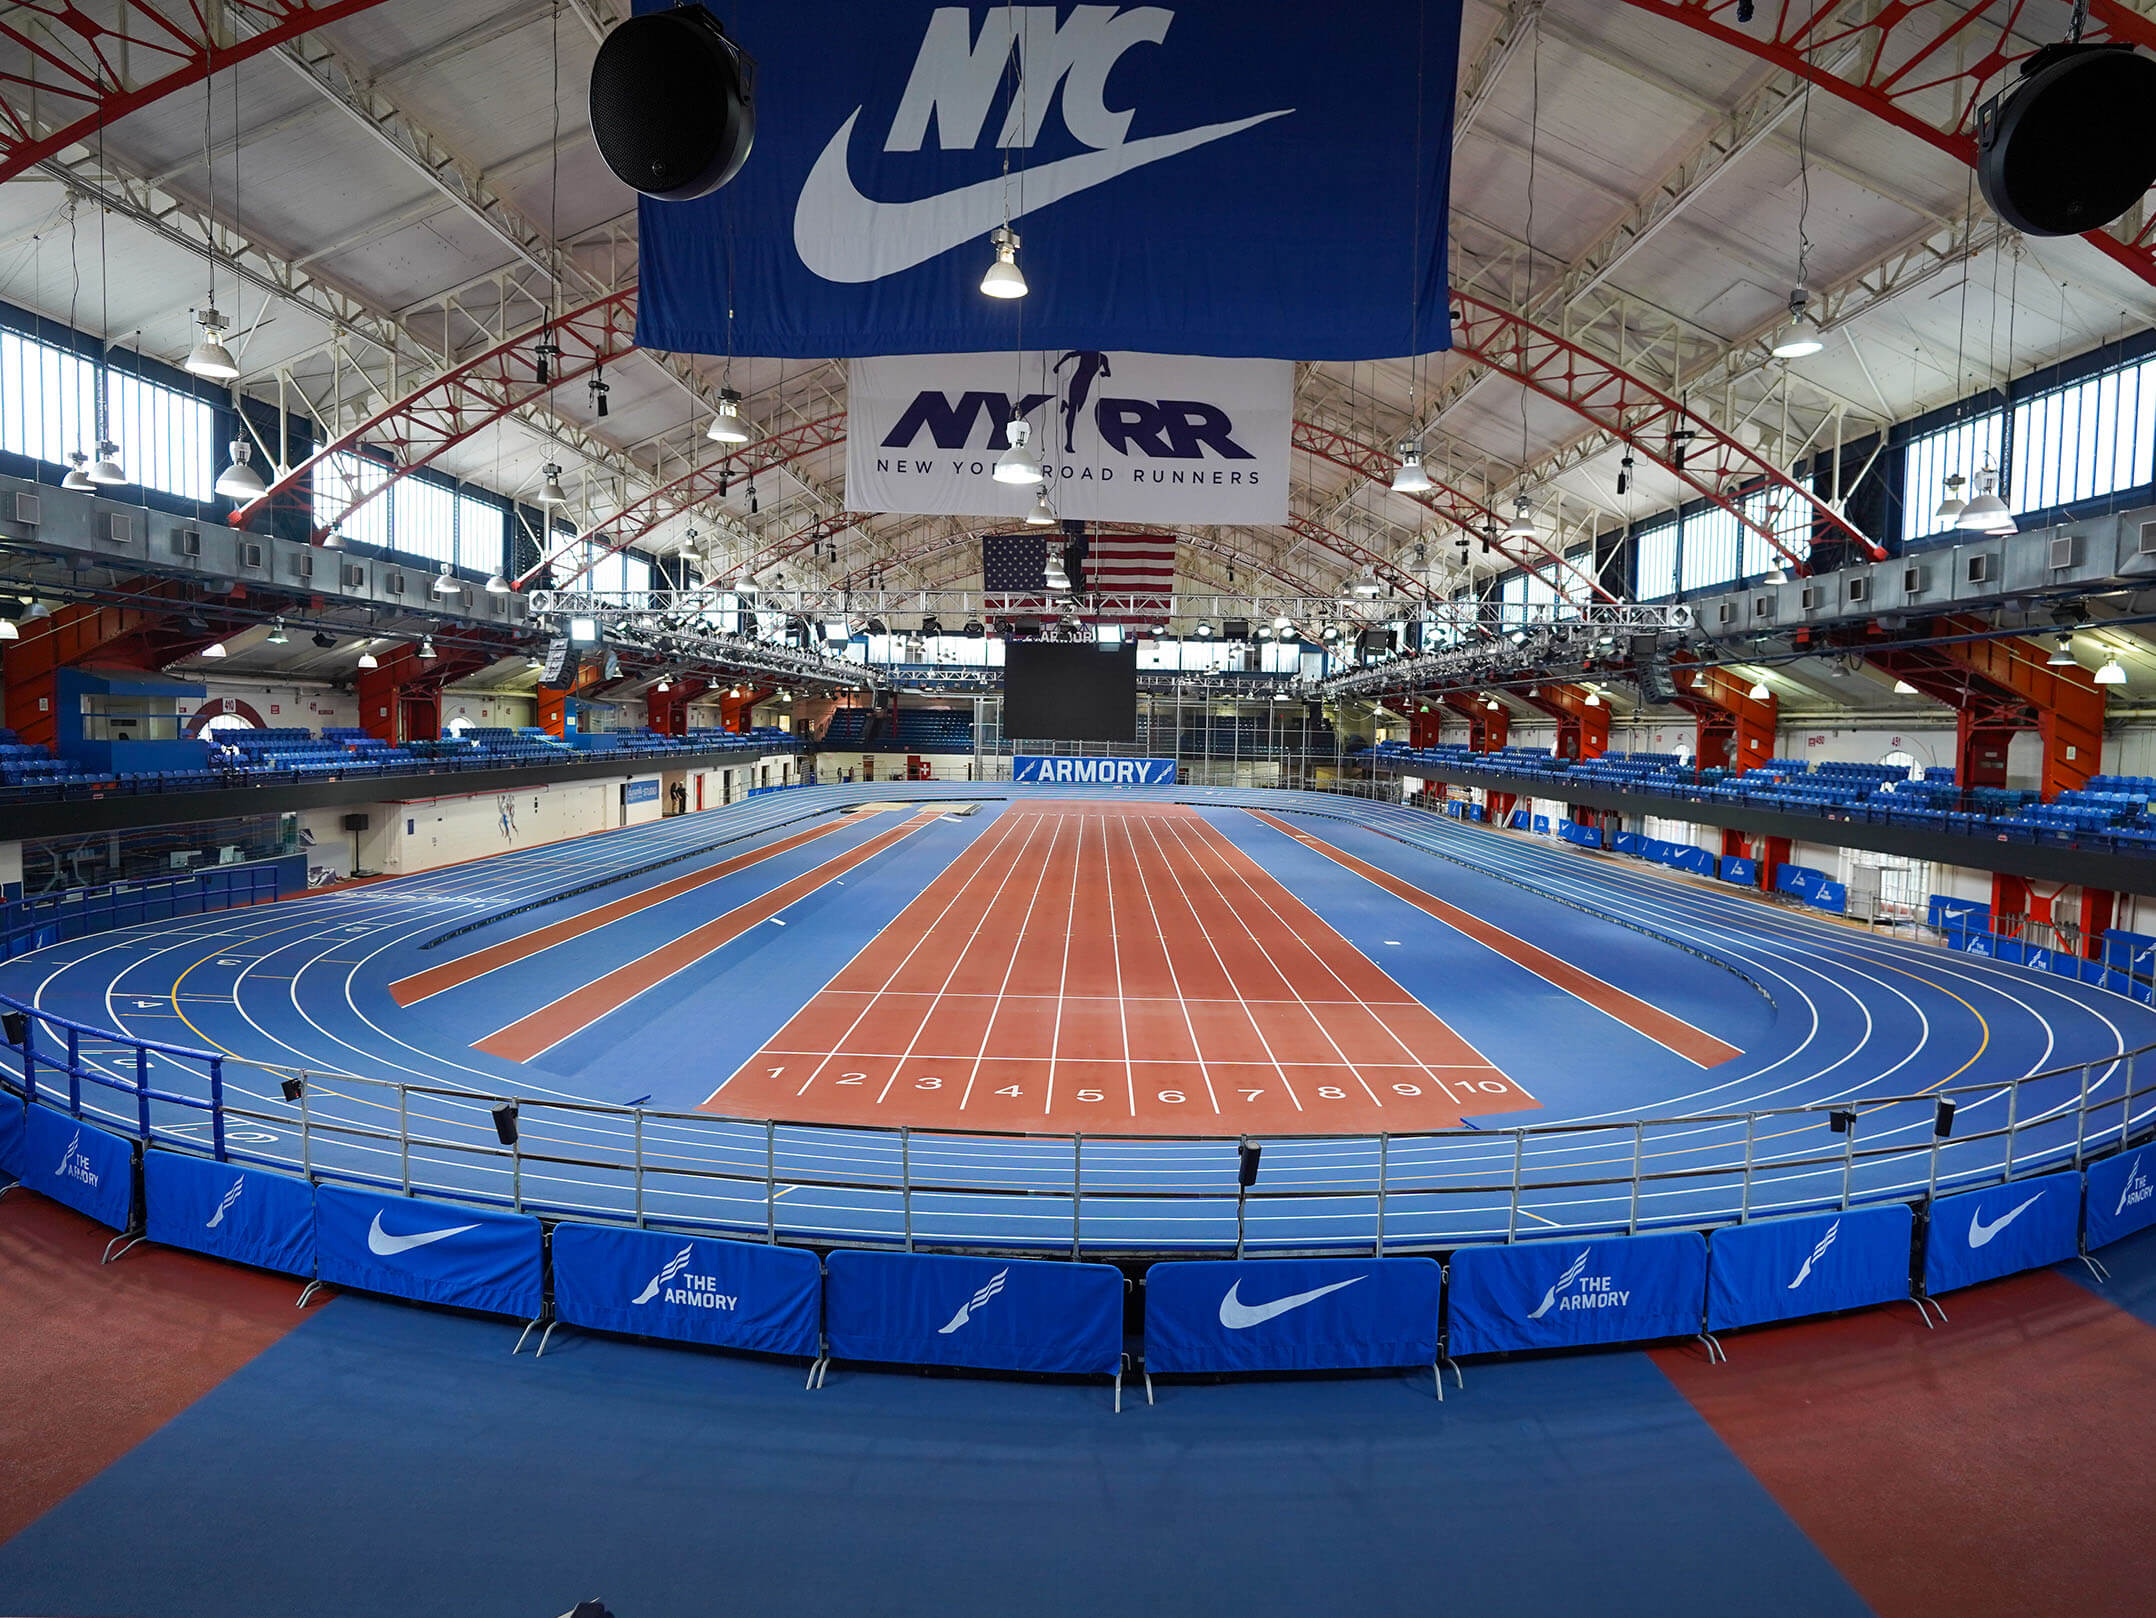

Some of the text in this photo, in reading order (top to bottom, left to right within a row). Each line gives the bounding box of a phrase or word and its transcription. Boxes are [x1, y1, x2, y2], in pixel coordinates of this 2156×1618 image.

[883, 4, 1175, 151] NYC
[876, 459, 932, 474] NEW
[1042, 464, 1114, 481] ROAD
[1133, 469, 1260, 484] RUNNERS
[1037, 759, 1152, 783] ARMORY
[766, 1066, 1508, 1104] 1 2 3 4 5 6 7 8 9 10
[76, 1153, 90, 1171] THE
[2135, 1174, 2147, 1190] THE
[2126, 1185, 2154, 1206] ARMORY
[683, 1273, 717, 1292] THE
[1579, 1276, 1612, 1292] THE
[664, 1287, 738, 1311] ARMORY
[1559, 1290, 1630, 1311] ARMORY
